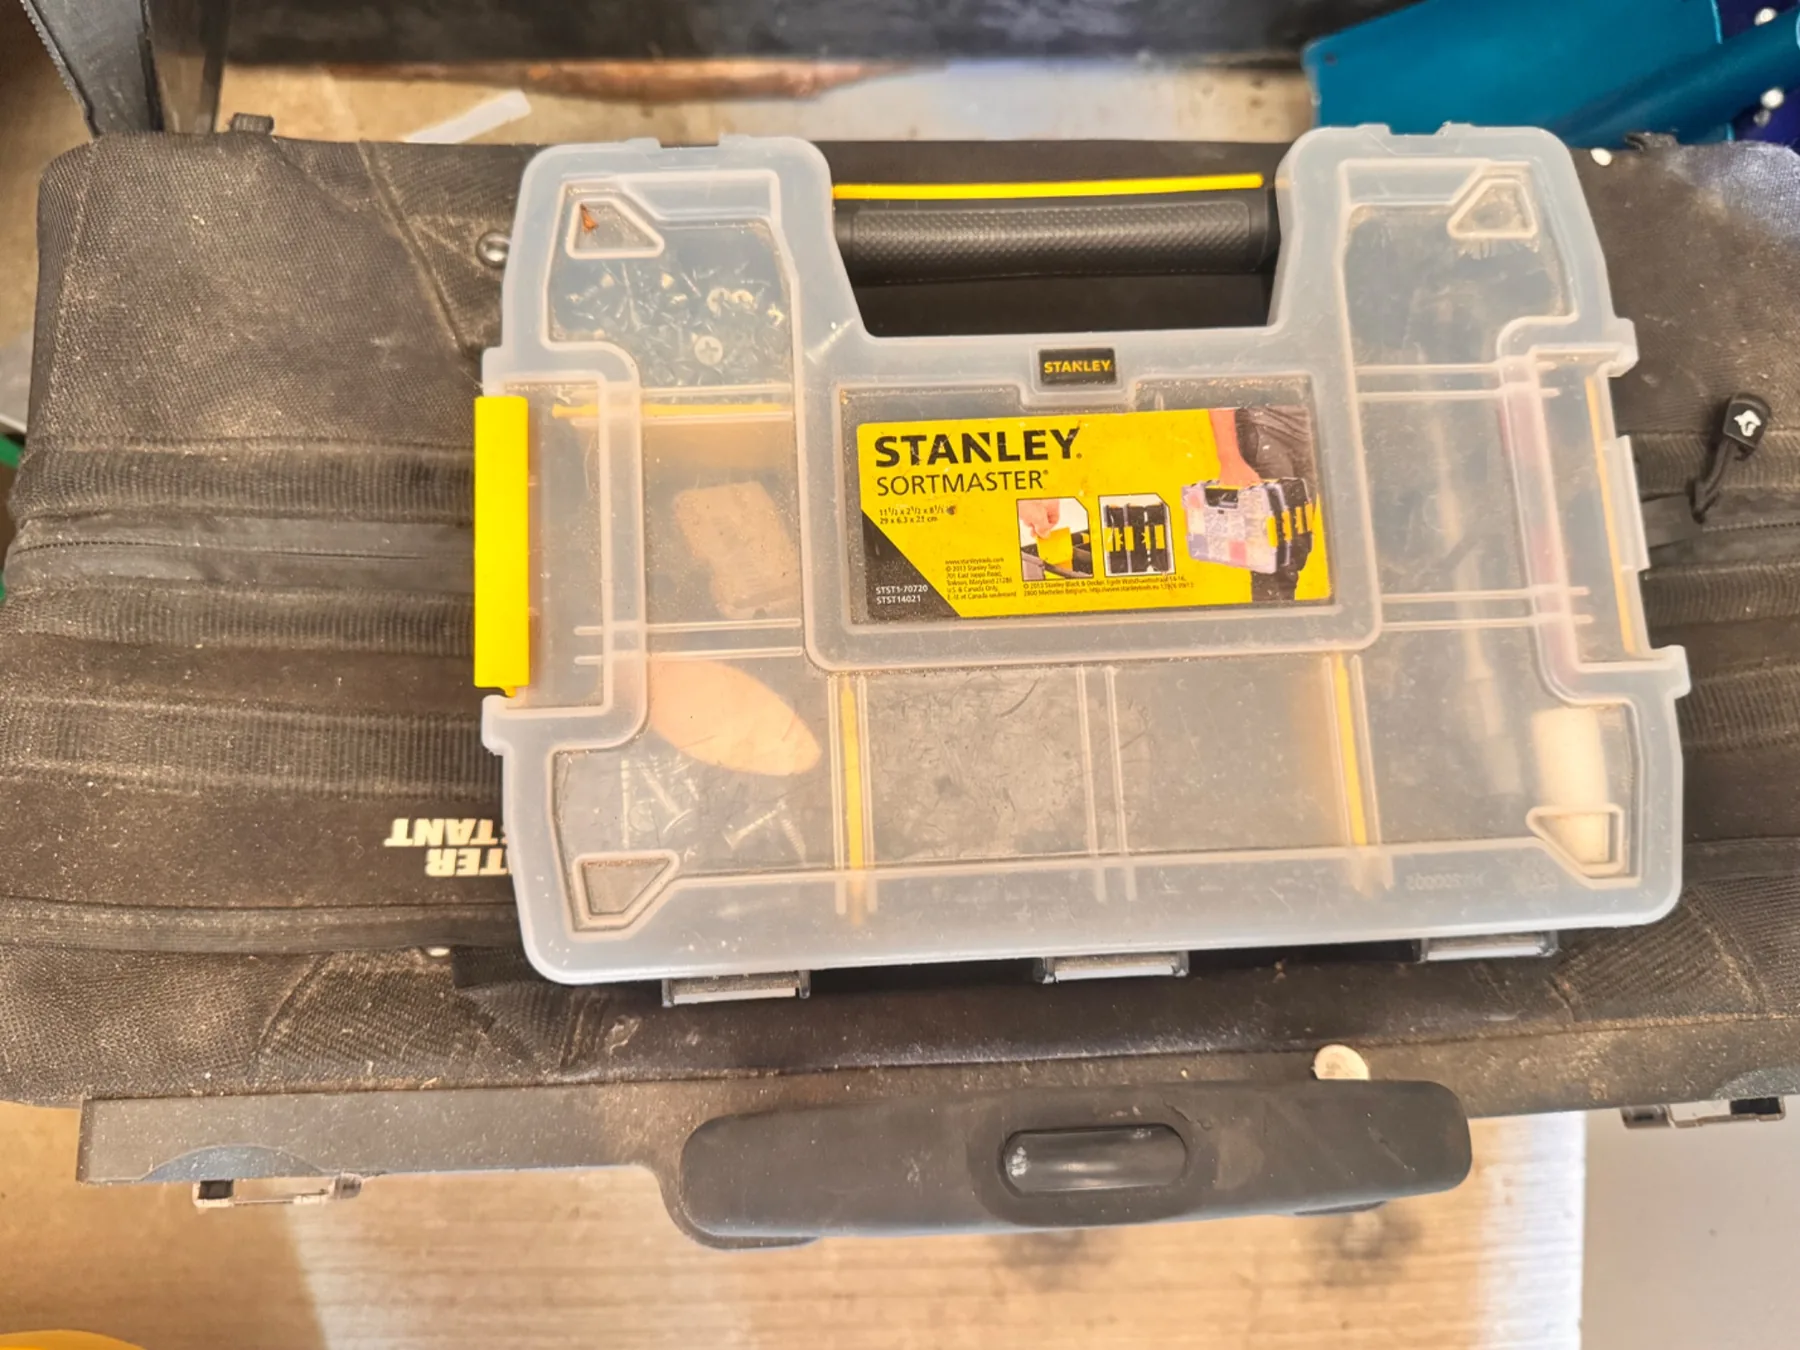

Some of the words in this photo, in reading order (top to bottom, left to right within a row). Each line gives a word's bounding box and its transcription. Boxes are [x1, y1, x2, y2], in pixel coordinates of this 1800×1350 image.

[1044, 360, 1111, 374] STANLEY
[875, 428, 1080, 467] STANLEY
[877, 471, 1044, 497] SORTMASTER
[875, 584, 929, 595] STST1-70720
[876, 594, 921, 605] STST14021
